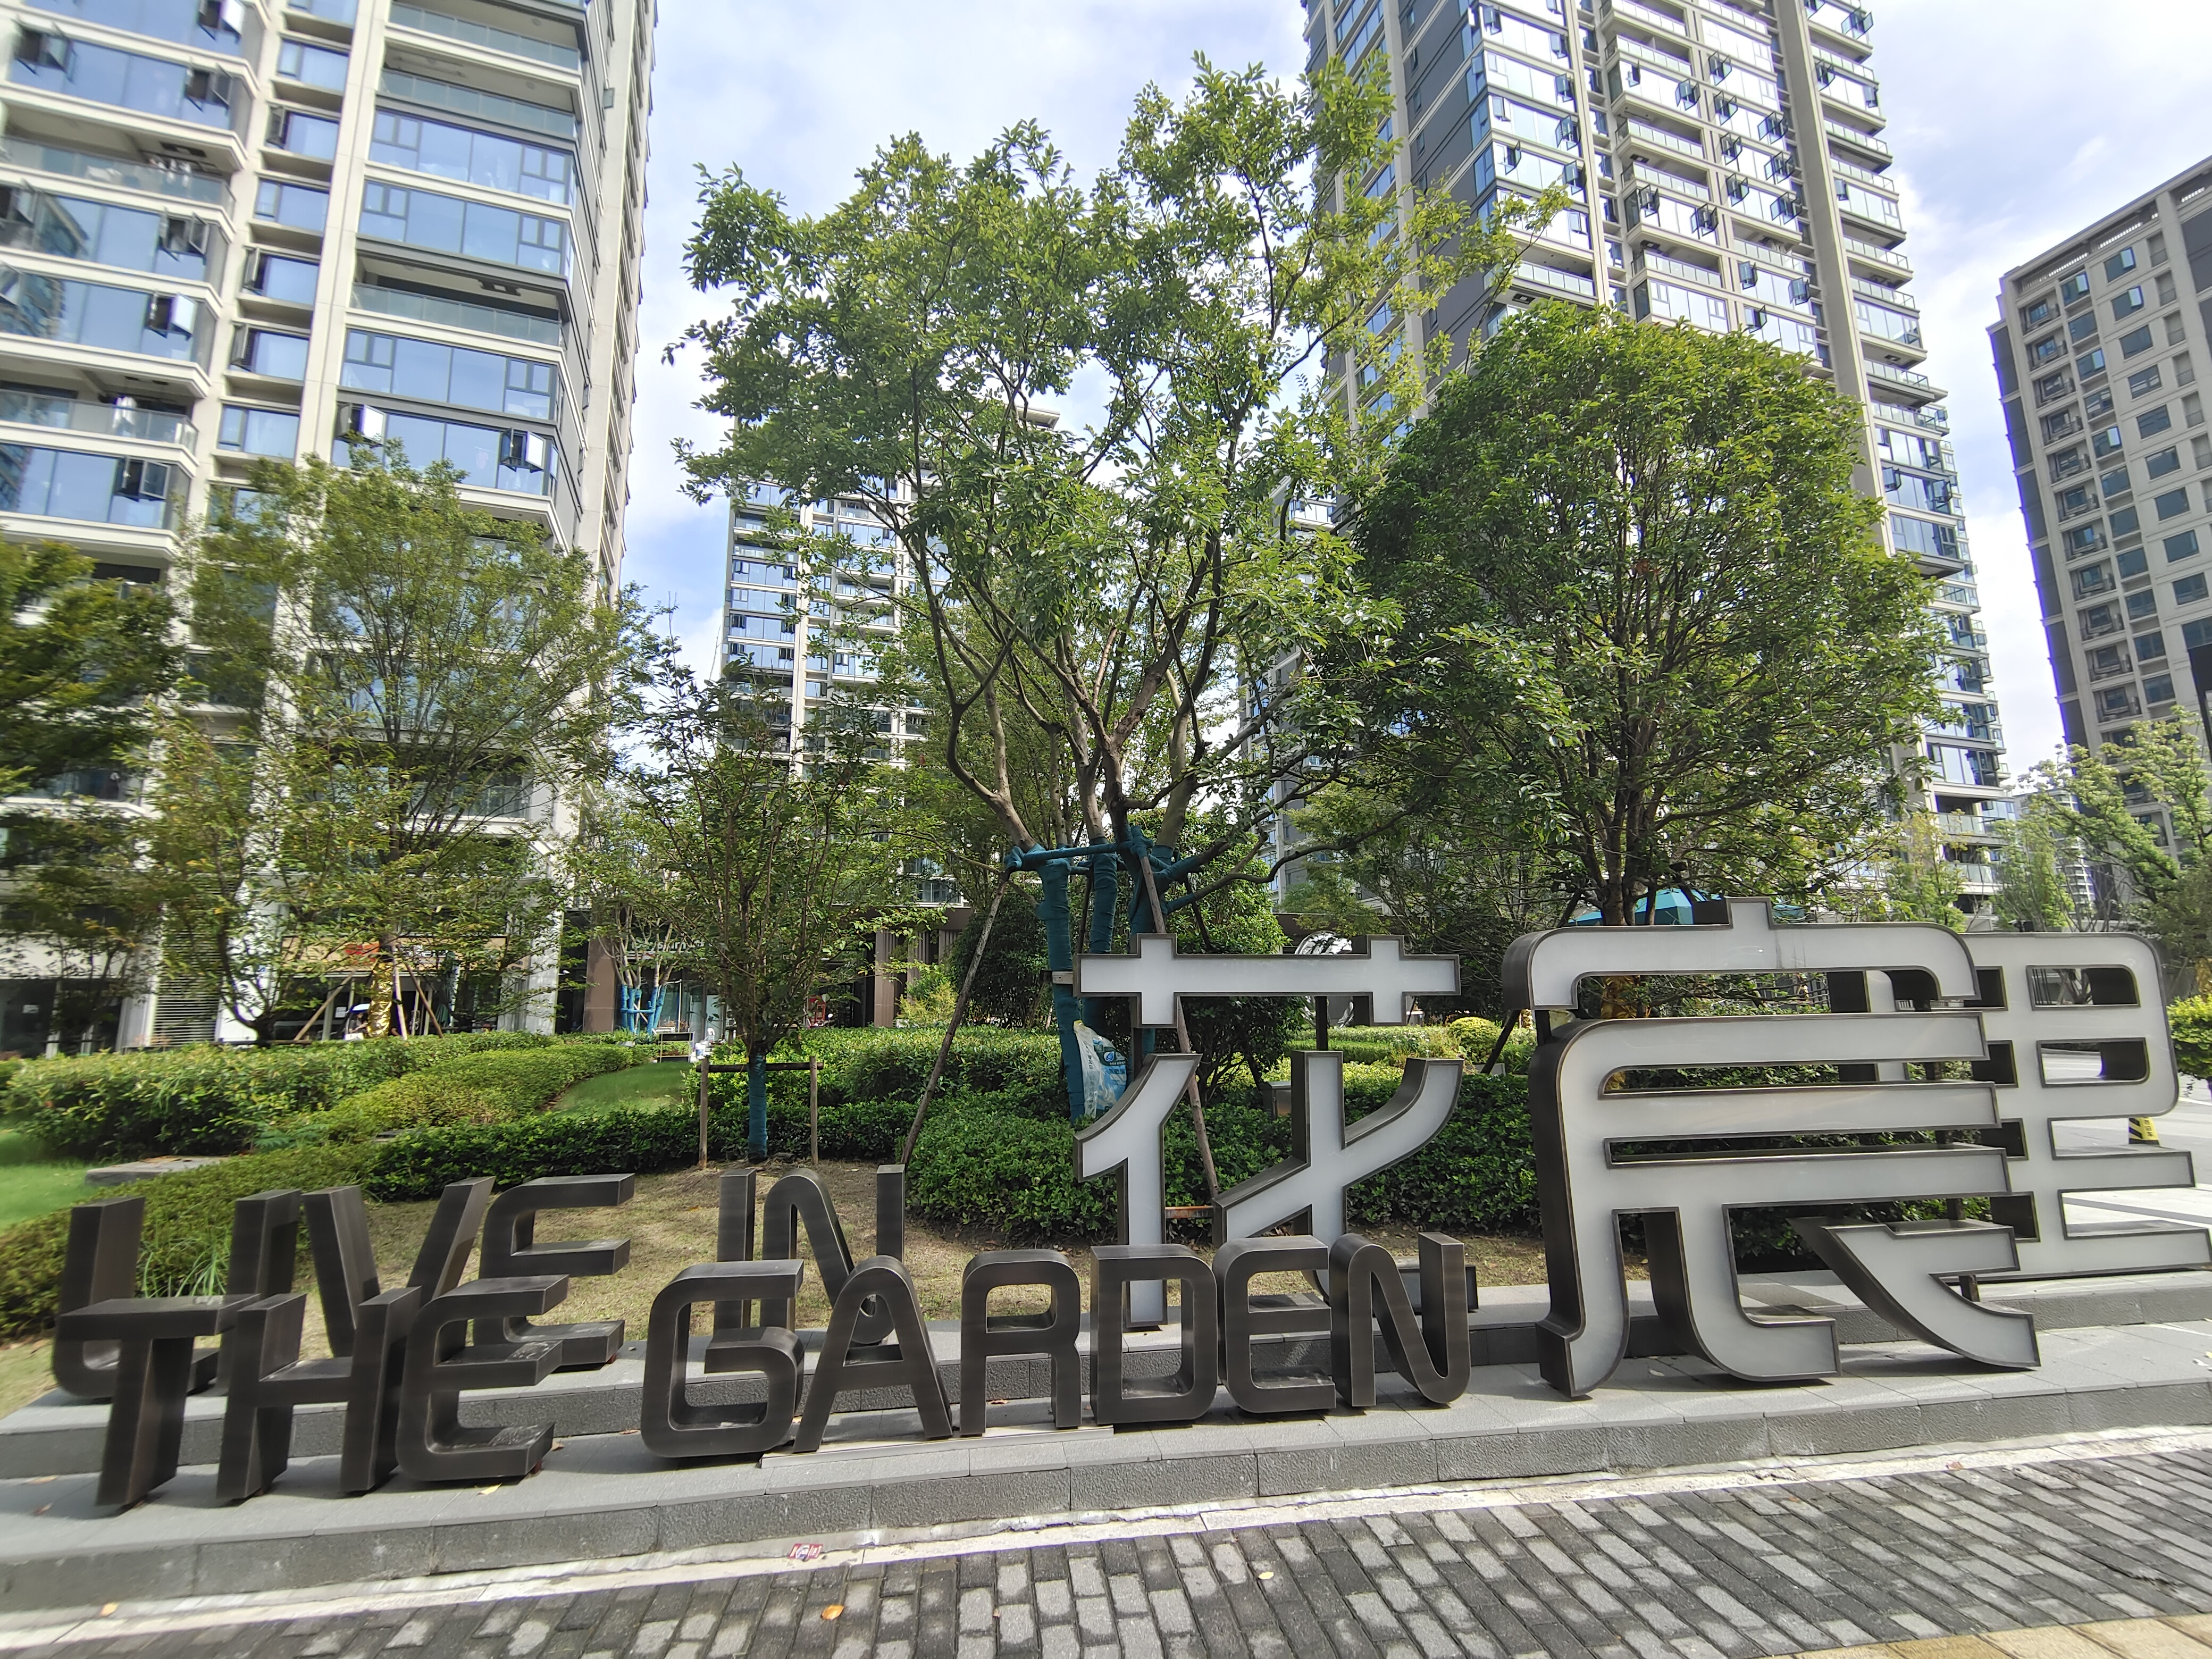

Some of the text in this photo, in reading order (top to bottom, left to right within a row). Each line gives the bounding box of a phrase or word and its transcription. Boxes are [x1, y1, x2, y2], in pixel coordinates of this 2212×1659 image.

[53, 1163, 906, 1399] LIVE IN
[55, 1231, 1471, 1505] THE GARDEN
